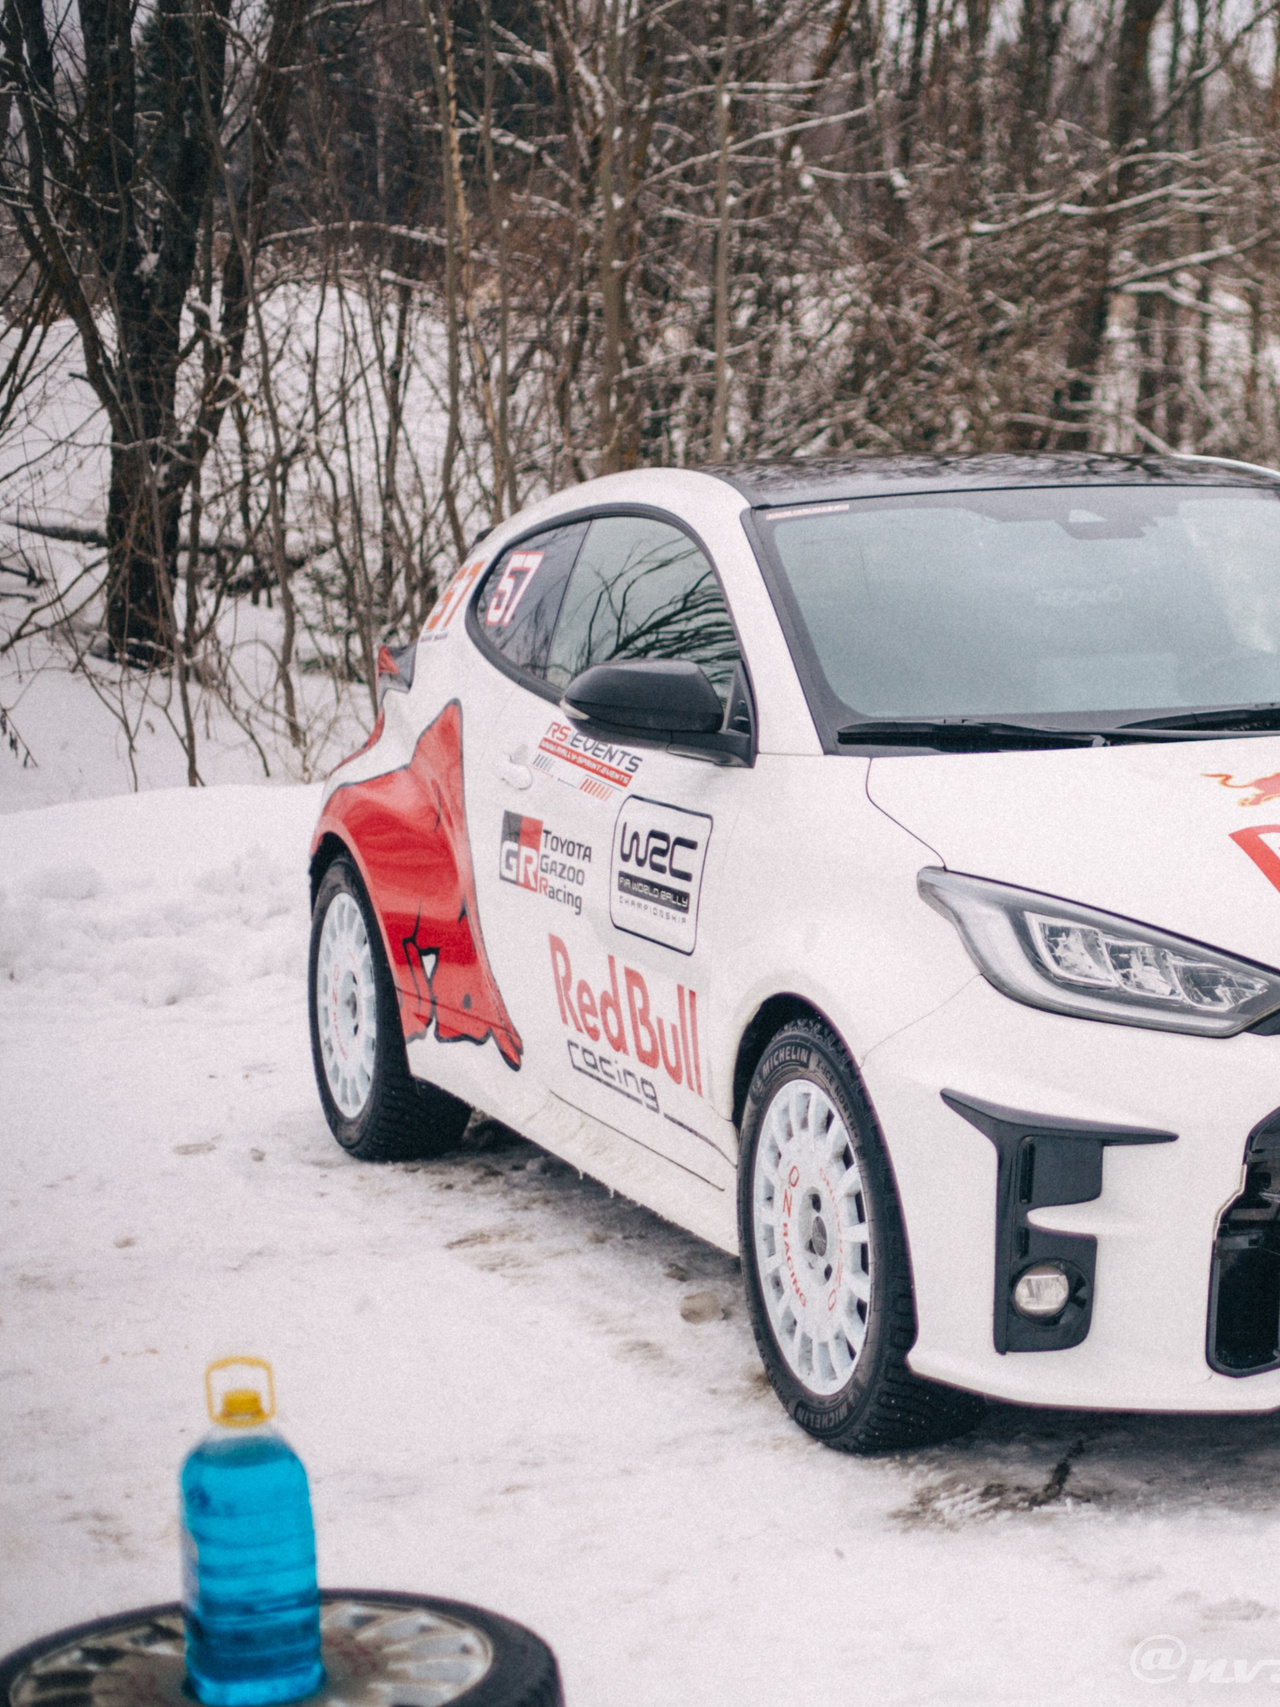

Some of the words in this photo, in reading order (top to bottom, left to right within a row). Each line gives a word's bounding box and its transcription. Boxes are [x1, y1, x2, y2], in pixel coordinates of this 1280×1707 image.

[485, 551, 546, 627] 57
[545, 721, 572, 742] RS
[570, 732, 643, 773] EVENTS
[500, 839, 541, 893] GR
[539, 854, 585, 886] GAZOO
[620, 821, 698, 882] WRC
[538, 875, 583, 915] Racing
[619, 876, 631, 889] FIA
[660, 889, 689, 908] RALLY
[619, 895, 687, 924] CHAMPIONSHIP
[549, 932, 629, 1056] Red
[624, 965, 703, 1098] Bull
[567, 1039, 660, 1114] racing
[762, 1045, 810, 1079] MICHELIN
